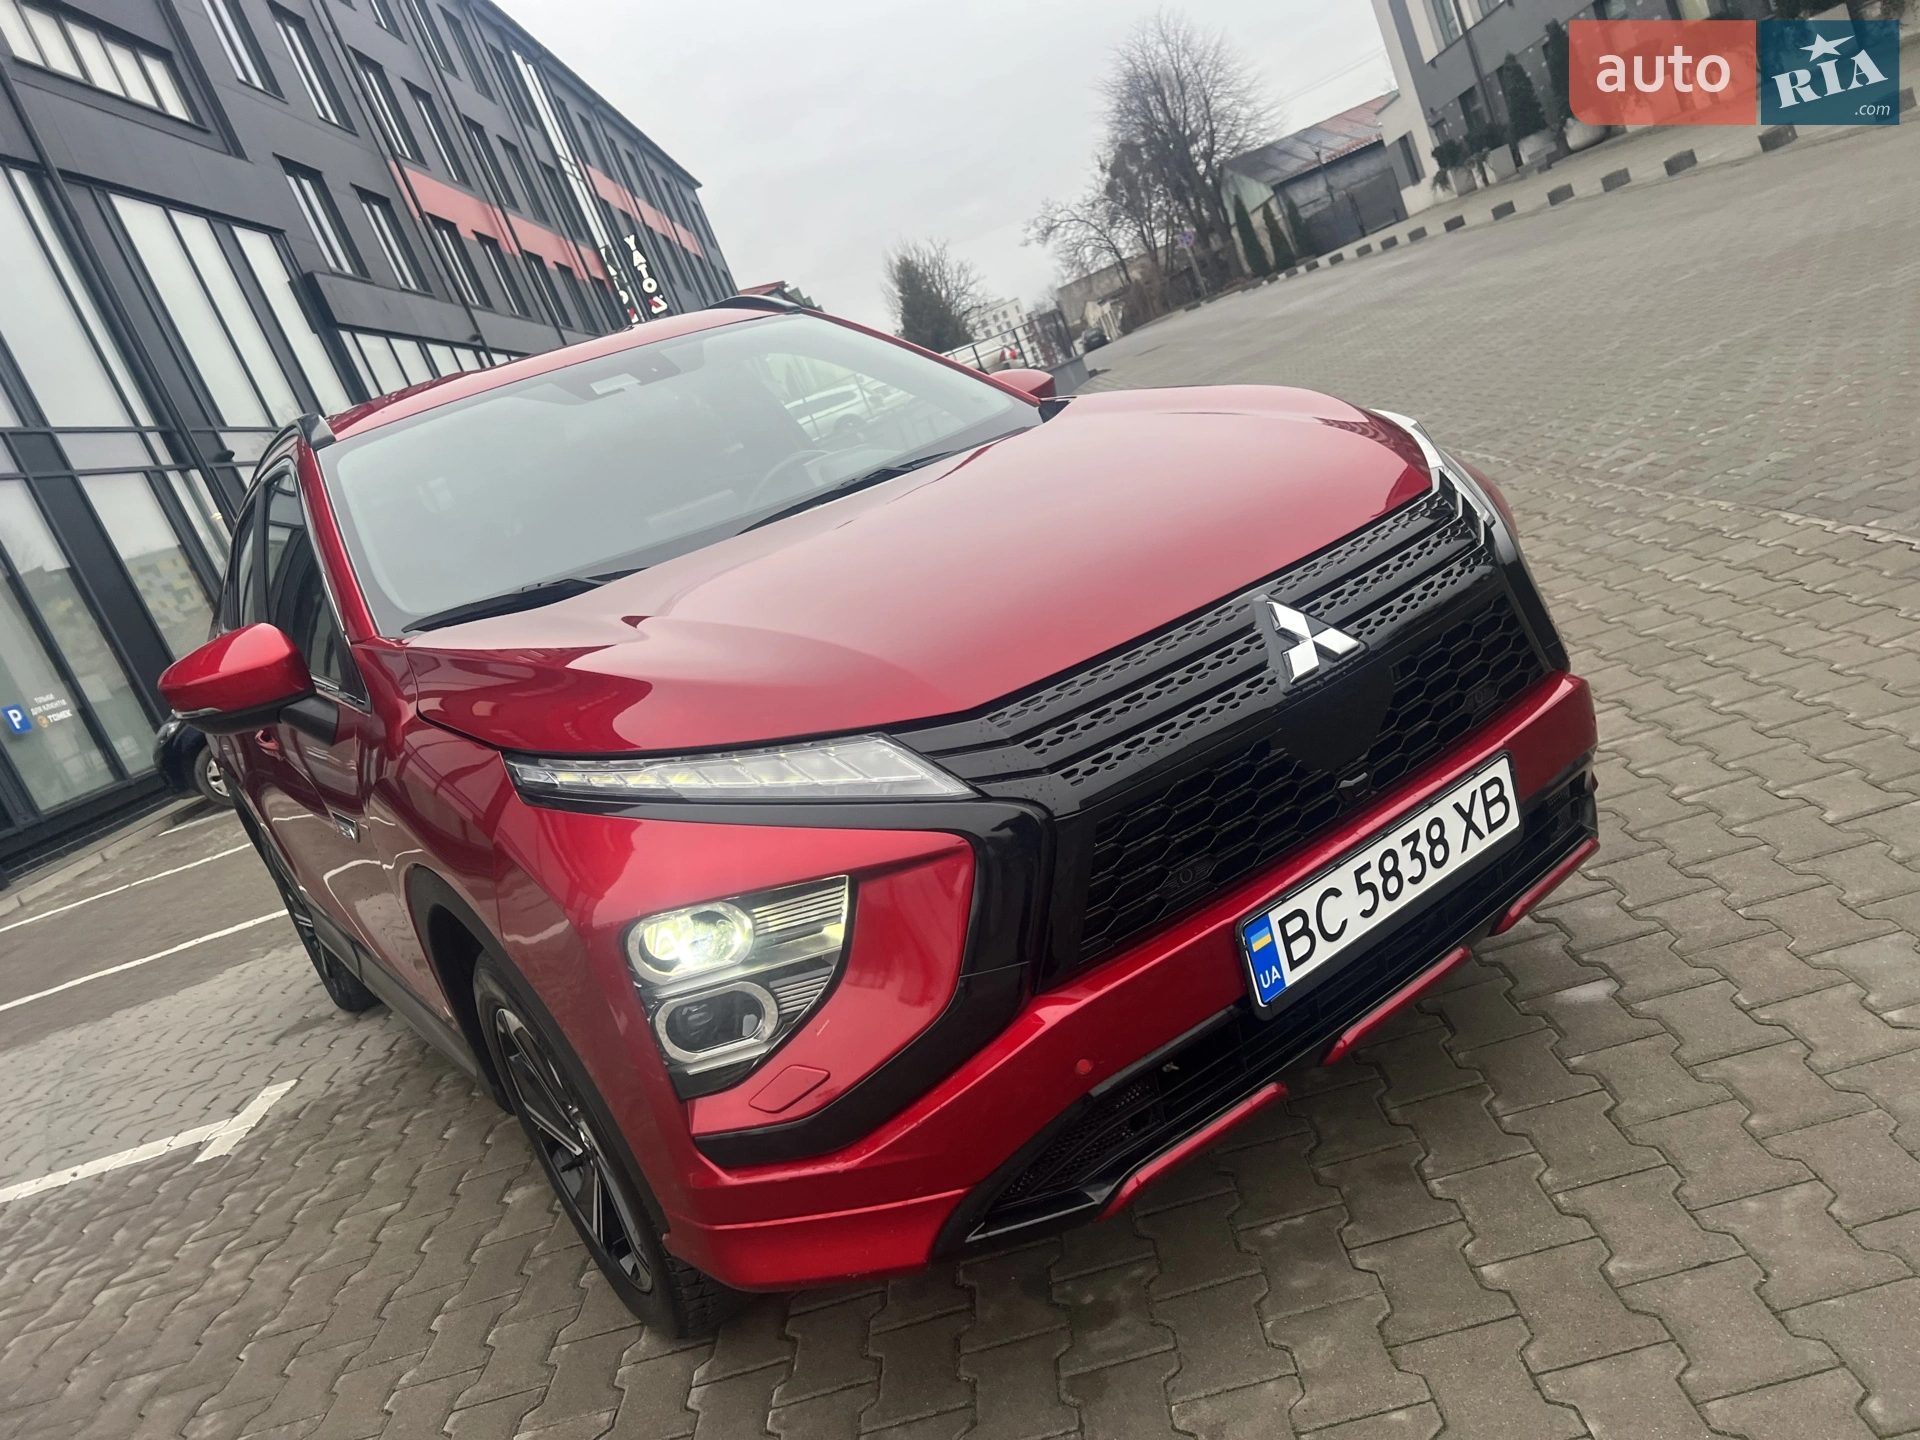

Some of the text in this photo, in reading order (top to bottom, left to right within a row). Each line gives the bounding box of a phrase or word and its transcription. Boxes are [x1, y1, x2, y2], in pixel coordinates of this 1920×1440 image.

[623, 234, 658, 294] YATO
[7, 709, 22, 729] P
[1277, 775, 1511, 972] BC 5838 XB
[1259, 965, 1282, 989] UA
